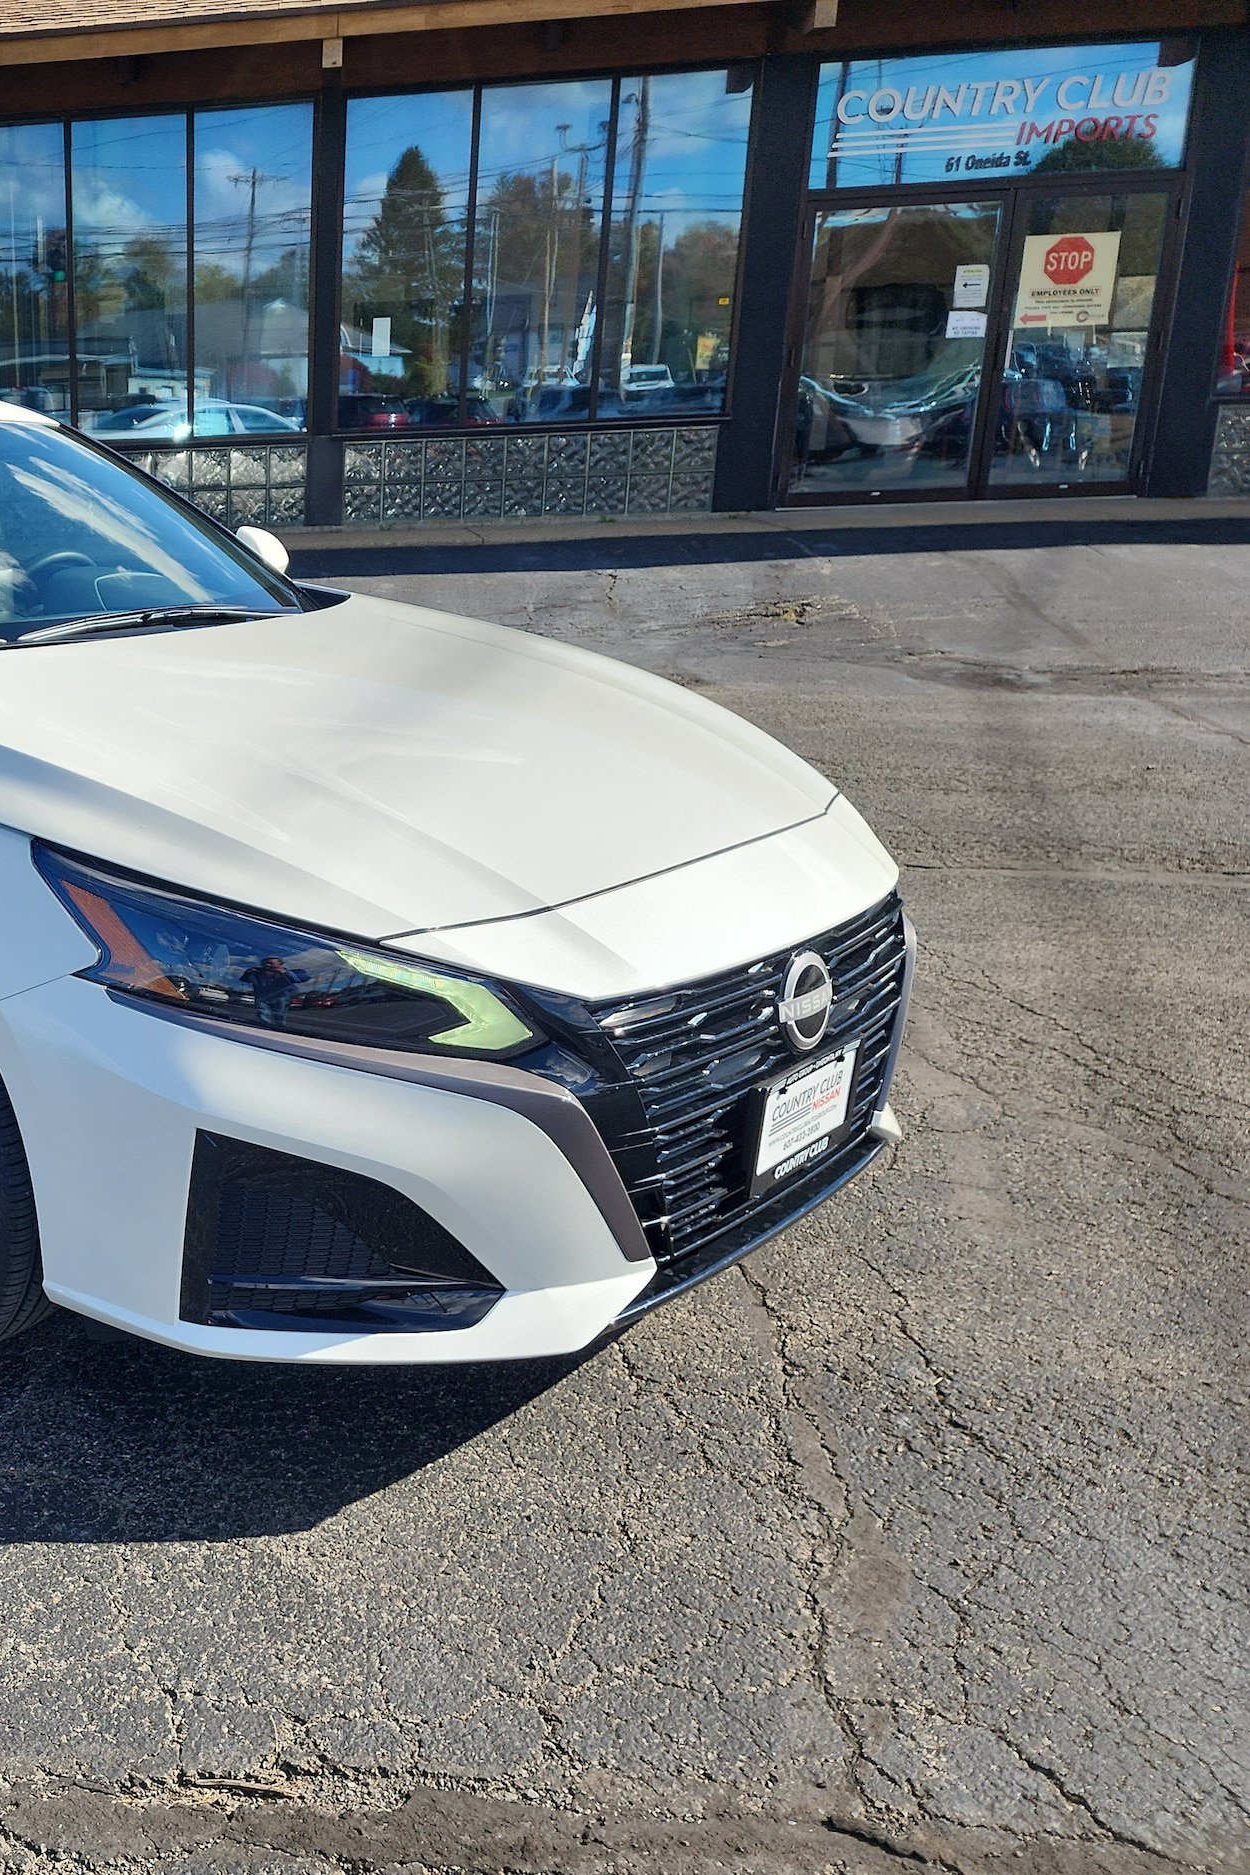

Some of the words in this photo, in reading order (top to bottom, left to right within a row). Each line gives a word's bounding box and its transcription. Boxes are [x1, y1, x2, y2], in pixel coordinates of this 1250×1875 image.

[836, 77, 1050, 126] COUNTRY
[1056, 70, 1174, 111] CLUB
[1015, 113, 1159, 146] IMPORTS
[945, 156, 960, 173] 61
[964, 153, 1011, 171] Oneida
[1013, 150, 1032, 168] St.
[1046, 250, 1092, 272] STOP
[1031, 288, 1077, 297] EMPLOYEES
[1079, 287, 1100, 296] ONLY
[772, 1083, 819, 1122] COUNTRY
[821, 1070, 843, 1095] CLUB
[812, 1087, 841, 1111] NISSAN
[774, 1146, 810, 1180] COUNTRY
[809, 1136, 829, 1158] CLUB
